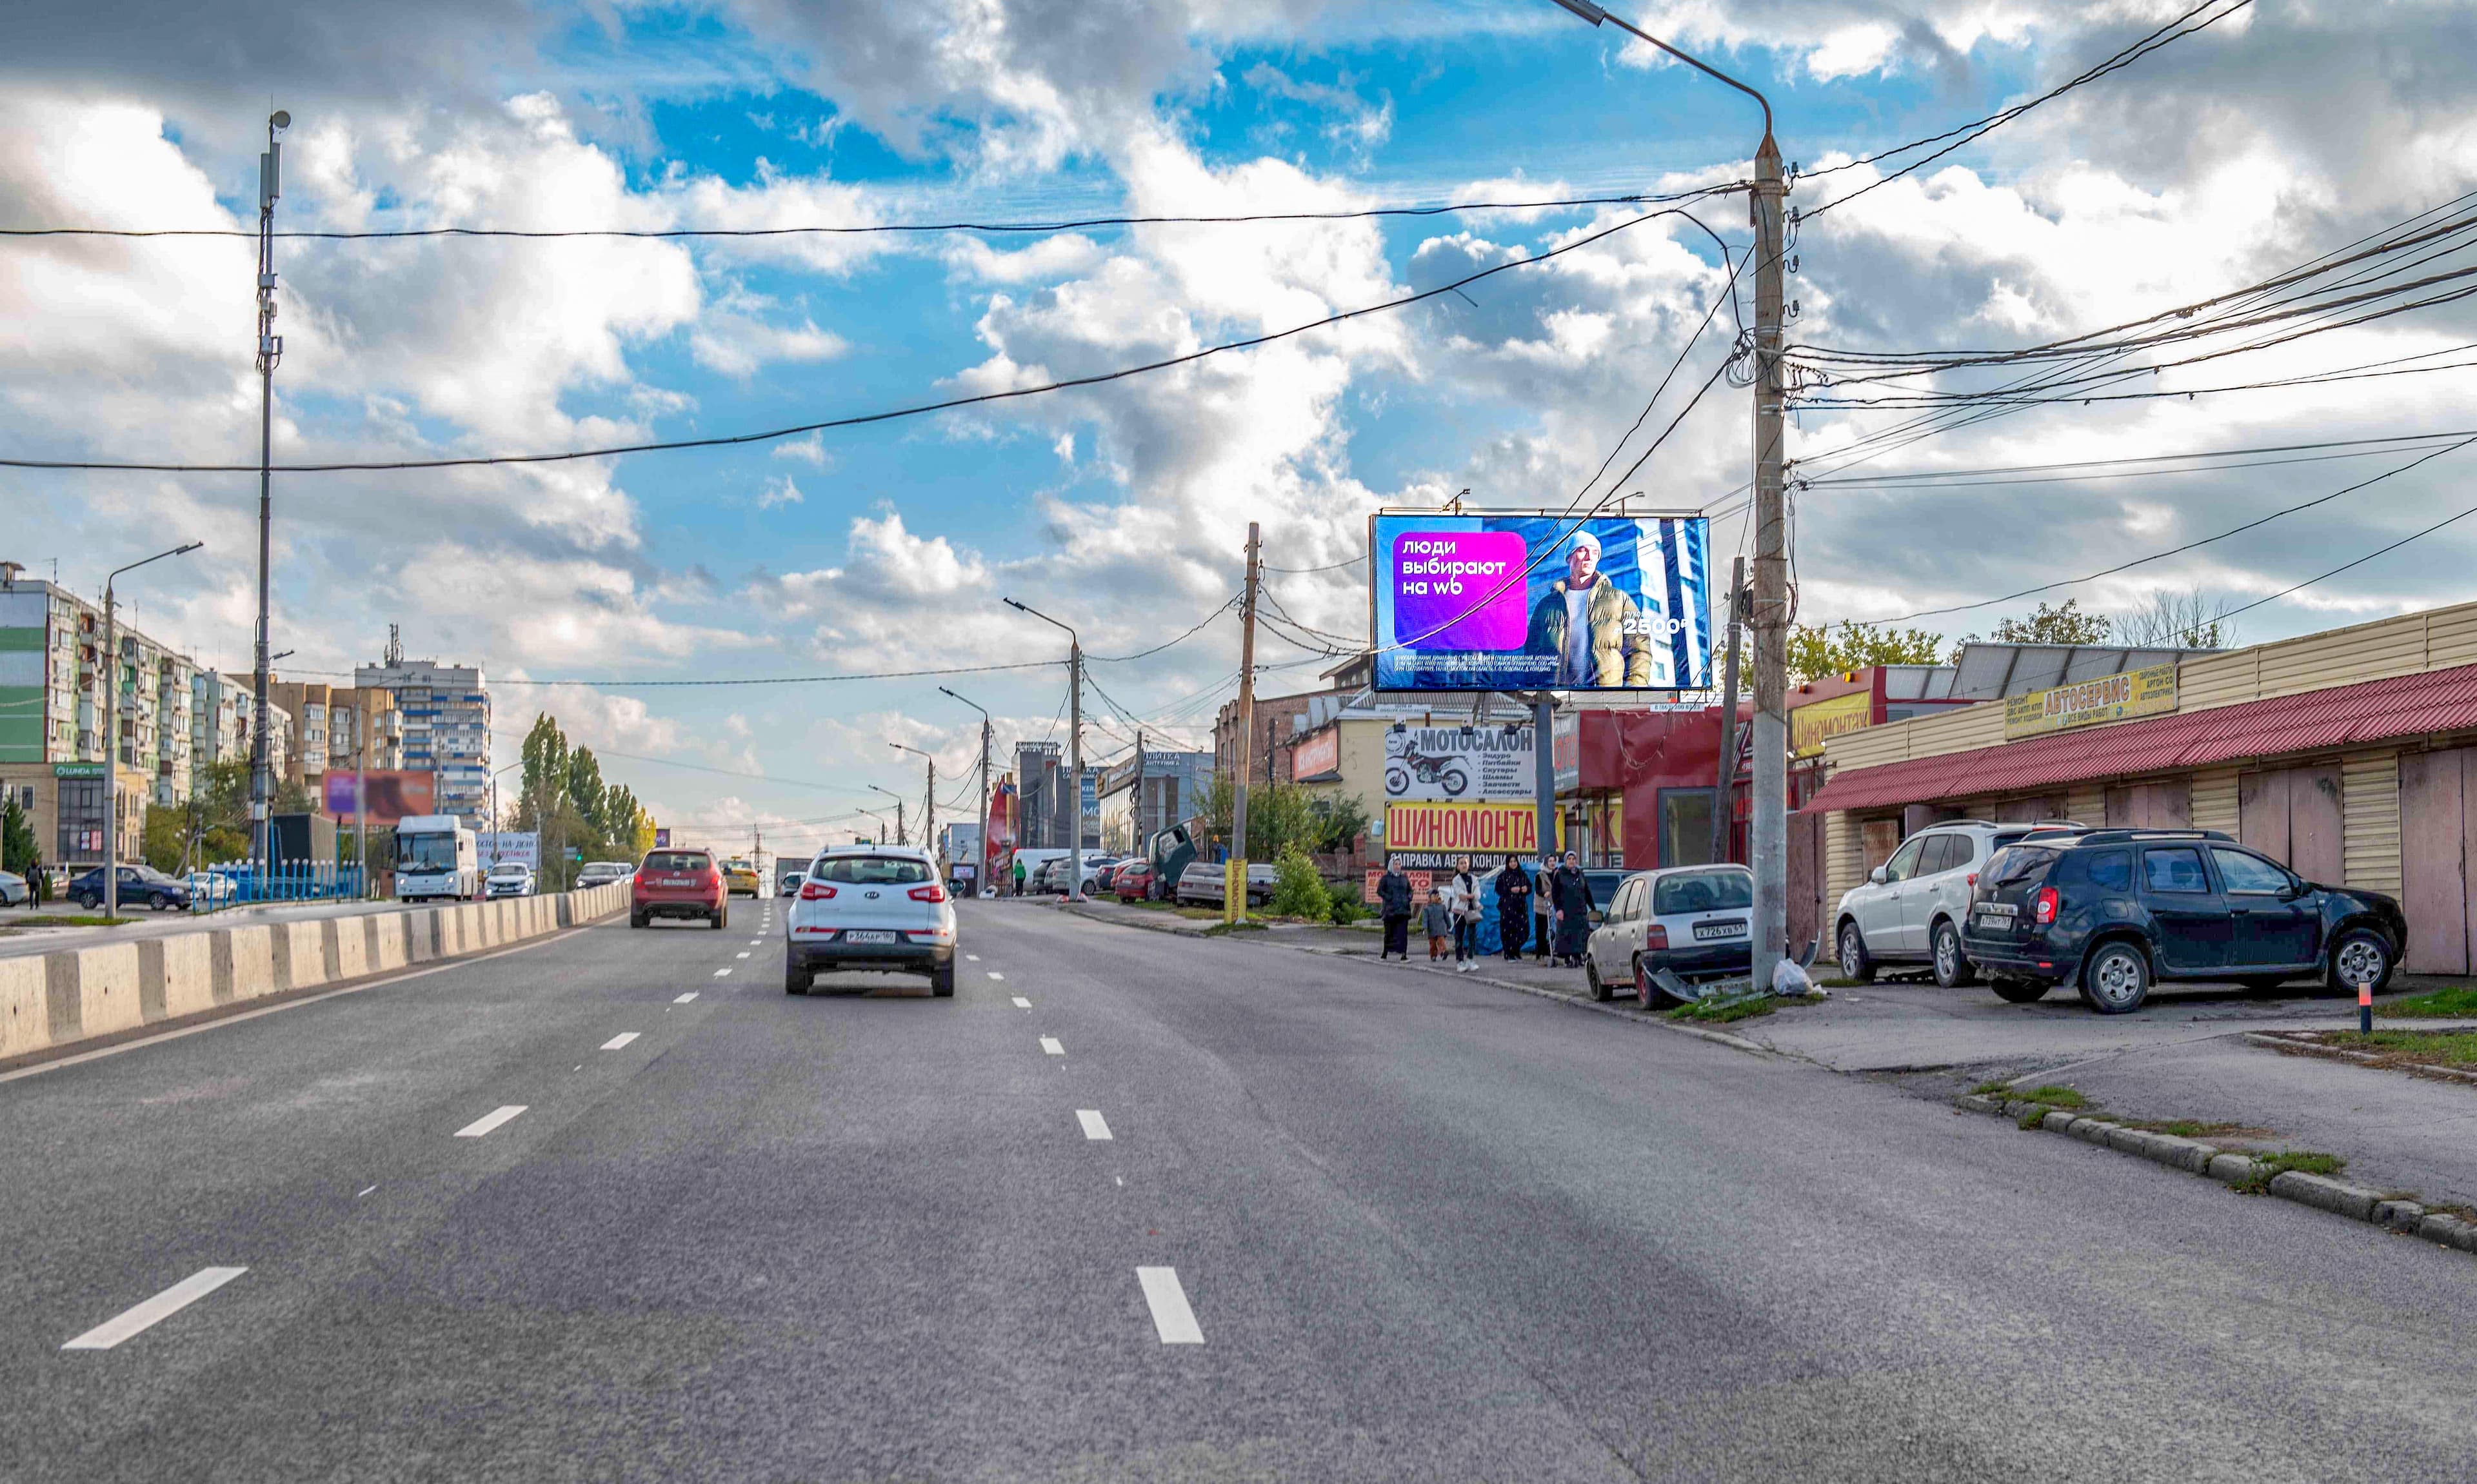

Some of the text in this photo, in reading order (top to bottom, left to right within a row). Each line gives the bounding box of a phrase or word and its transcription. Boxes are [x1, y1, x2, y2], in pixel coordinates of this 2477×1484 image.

[1402, 540, 1456, 556] люди
[1402, 557, 1506, 578] выбирают
[1402, 577, 1463, 595] на wb
[2147, 678, 2164, 688] АРГОН
[2007, 696, 2028, 707] РЕМОНТ
[2045, 677, 2129, 716] АВТОСЕРВИС
[2067, 707, 2109, 723] ВСЕ ВИДЫ РАБОТ
[1793, 711, 1868, 749] Шиномонтаж
[1421, 729, 1533, 752] МОТОСАЛОН
[1555, 733, 1577, 771] ОТО
